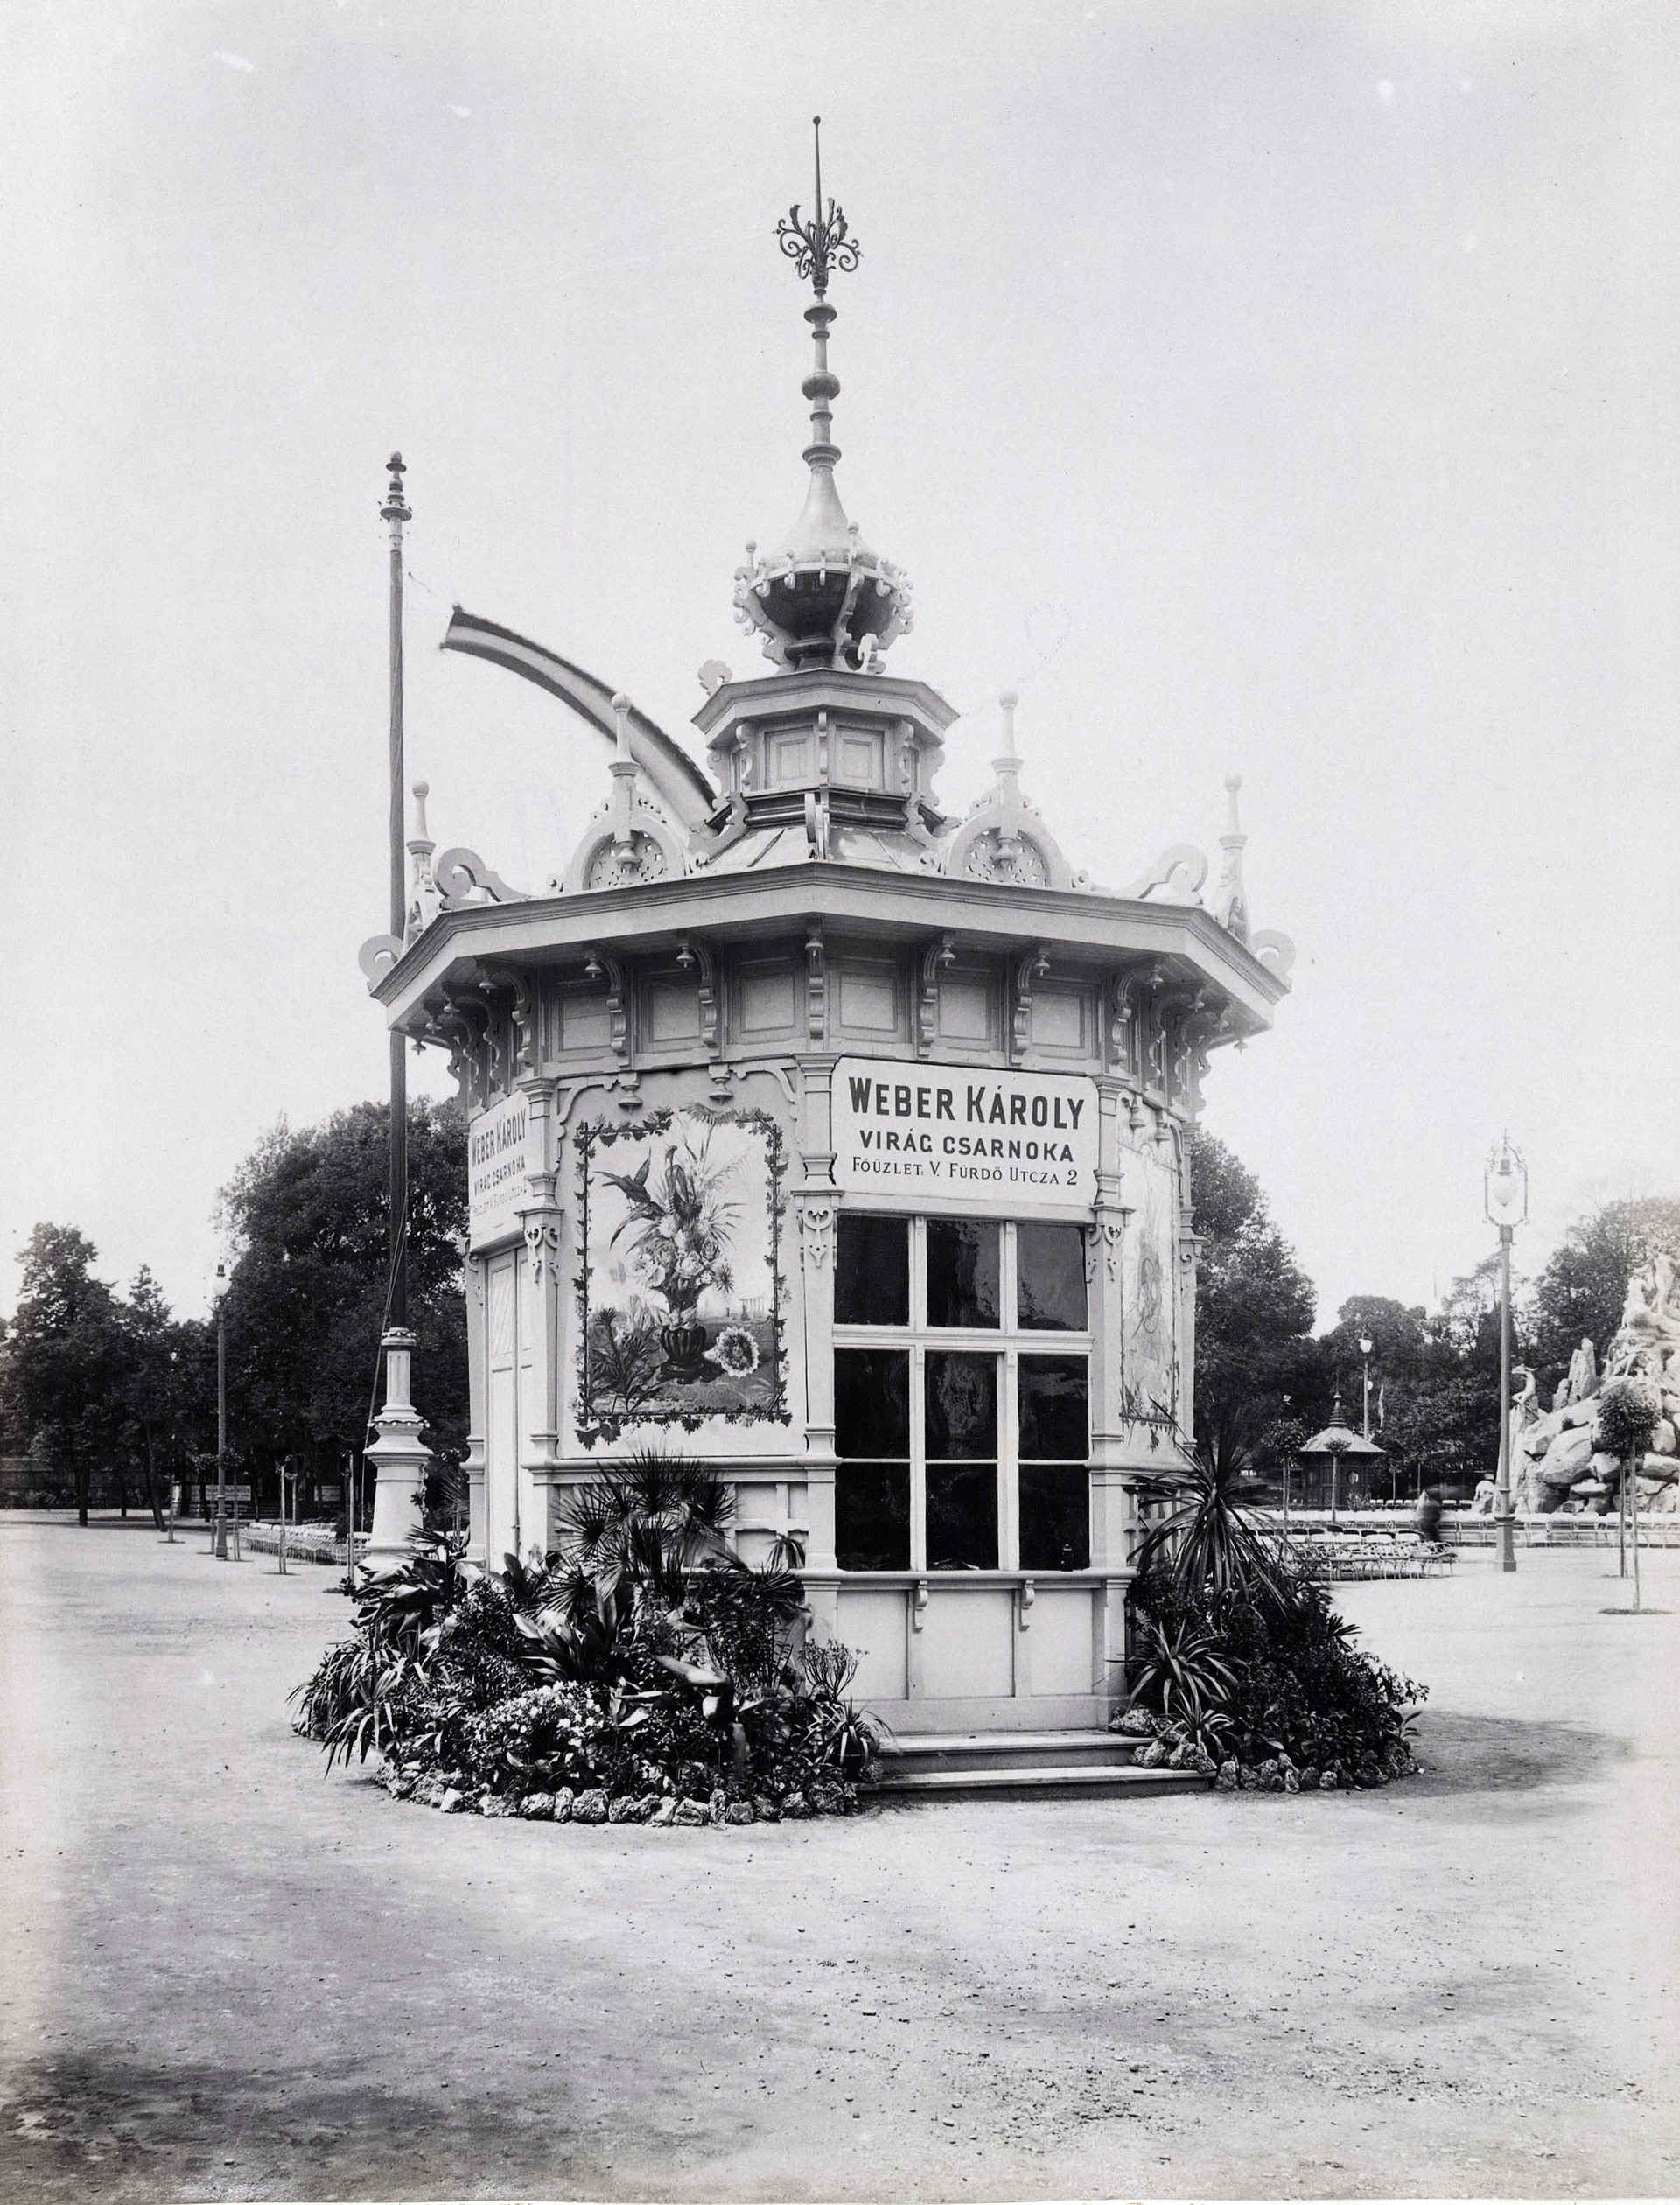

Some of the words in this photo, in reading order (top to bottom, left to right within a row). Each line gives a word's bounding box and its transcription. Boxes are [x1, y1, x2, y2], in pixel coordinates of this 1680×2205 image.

[849, 1077, 956, 1121] WEBER
[966, 1085, 1084, 1130] KÁROLY
[472, 1130, 495, 1167] WEBER
[496, 1108, 526, 1154] KÁROLY
[859, 1129, 933, 1153] VIRÁG
[943, 1136, 1074, 1162] CSARNOKA
[929, 1161, 941, 1177] V.
[1010, 1167, 1060, 1185] UTCZA
[1067, 1170, 1078, 1186] 2
